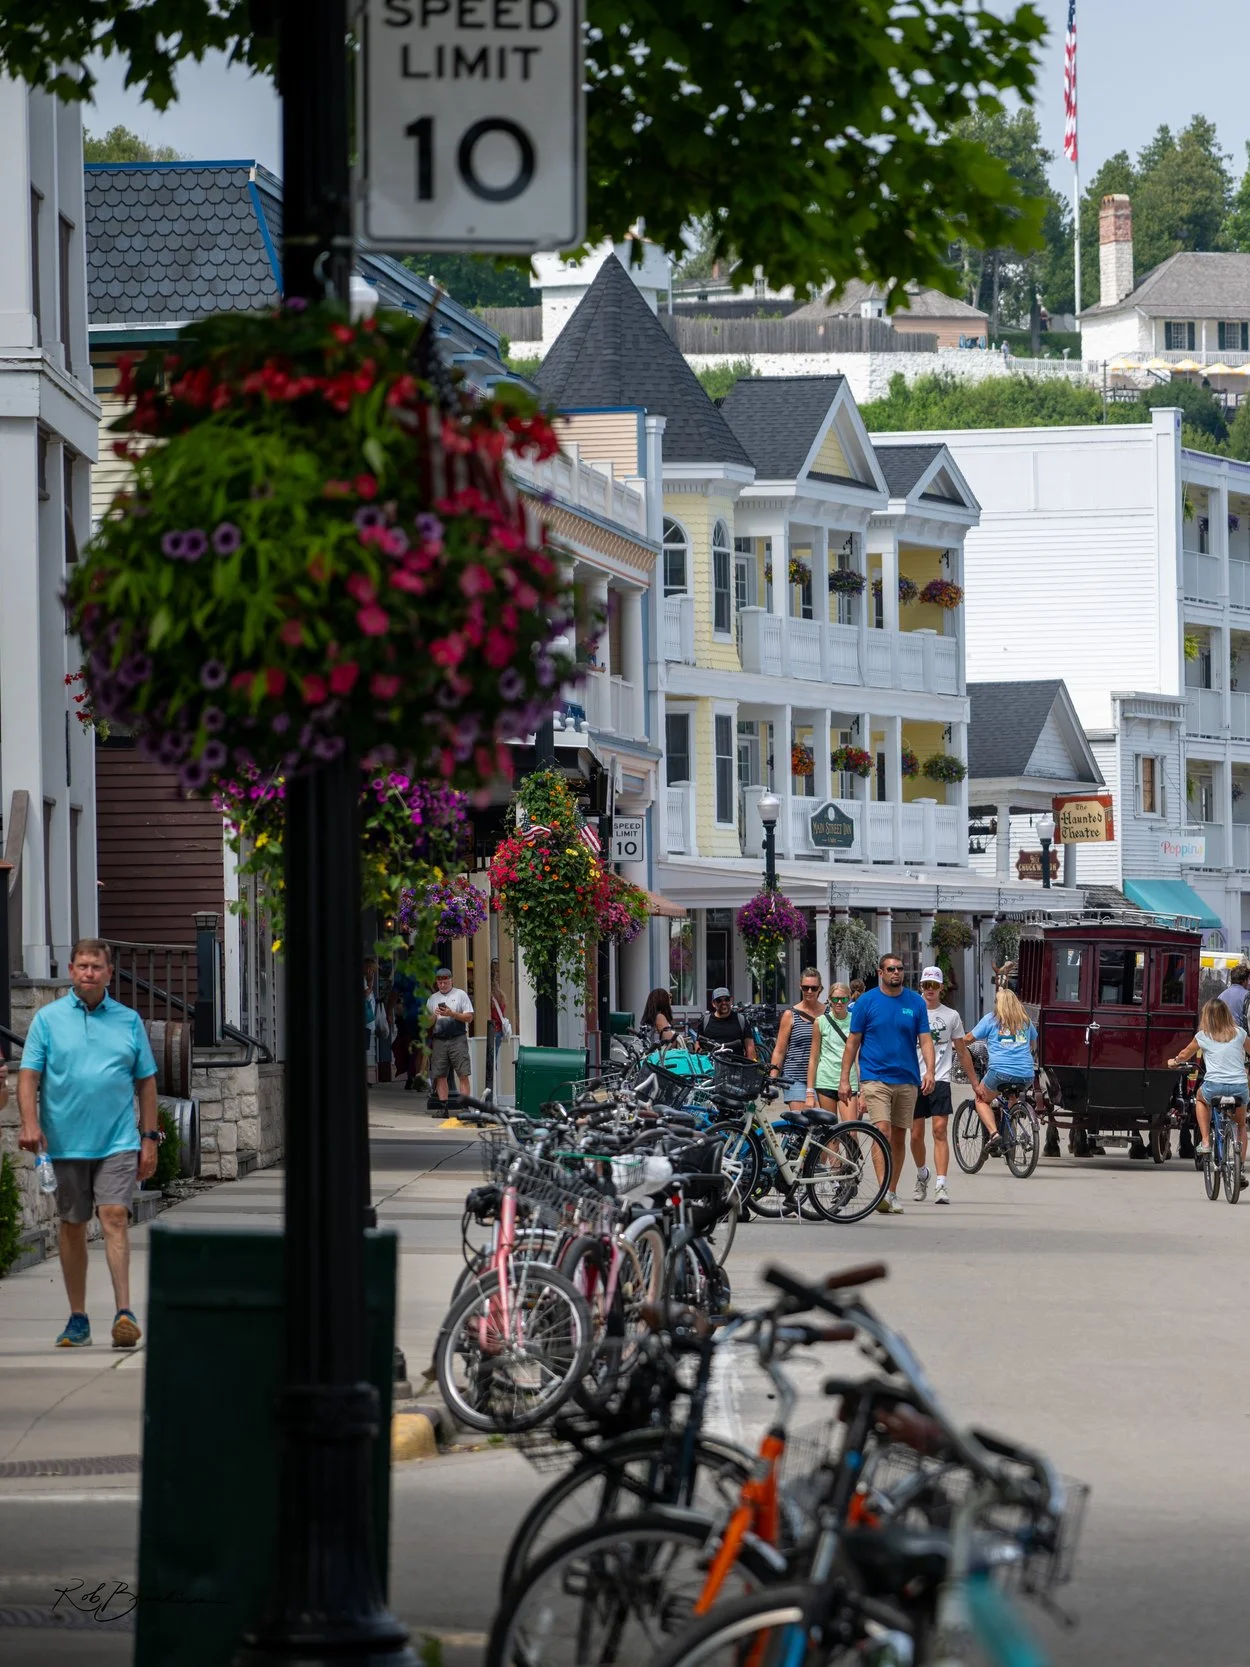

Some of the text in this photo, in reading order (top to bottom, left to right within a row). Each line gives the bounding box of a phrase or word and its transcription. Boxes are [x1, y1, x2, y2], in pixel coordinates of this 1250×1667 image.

[383, 0, 560, 31] SPEED
[402, 45, 542, 80] LIMIT
[404, 114, 536, 203] 10
[1062, 810, 1102, 825] Haunted
[613, 822, 641, 830] SPEED
[1061, 826, 1101, 840] Theatre
[617, 841, 637, 856] 10
